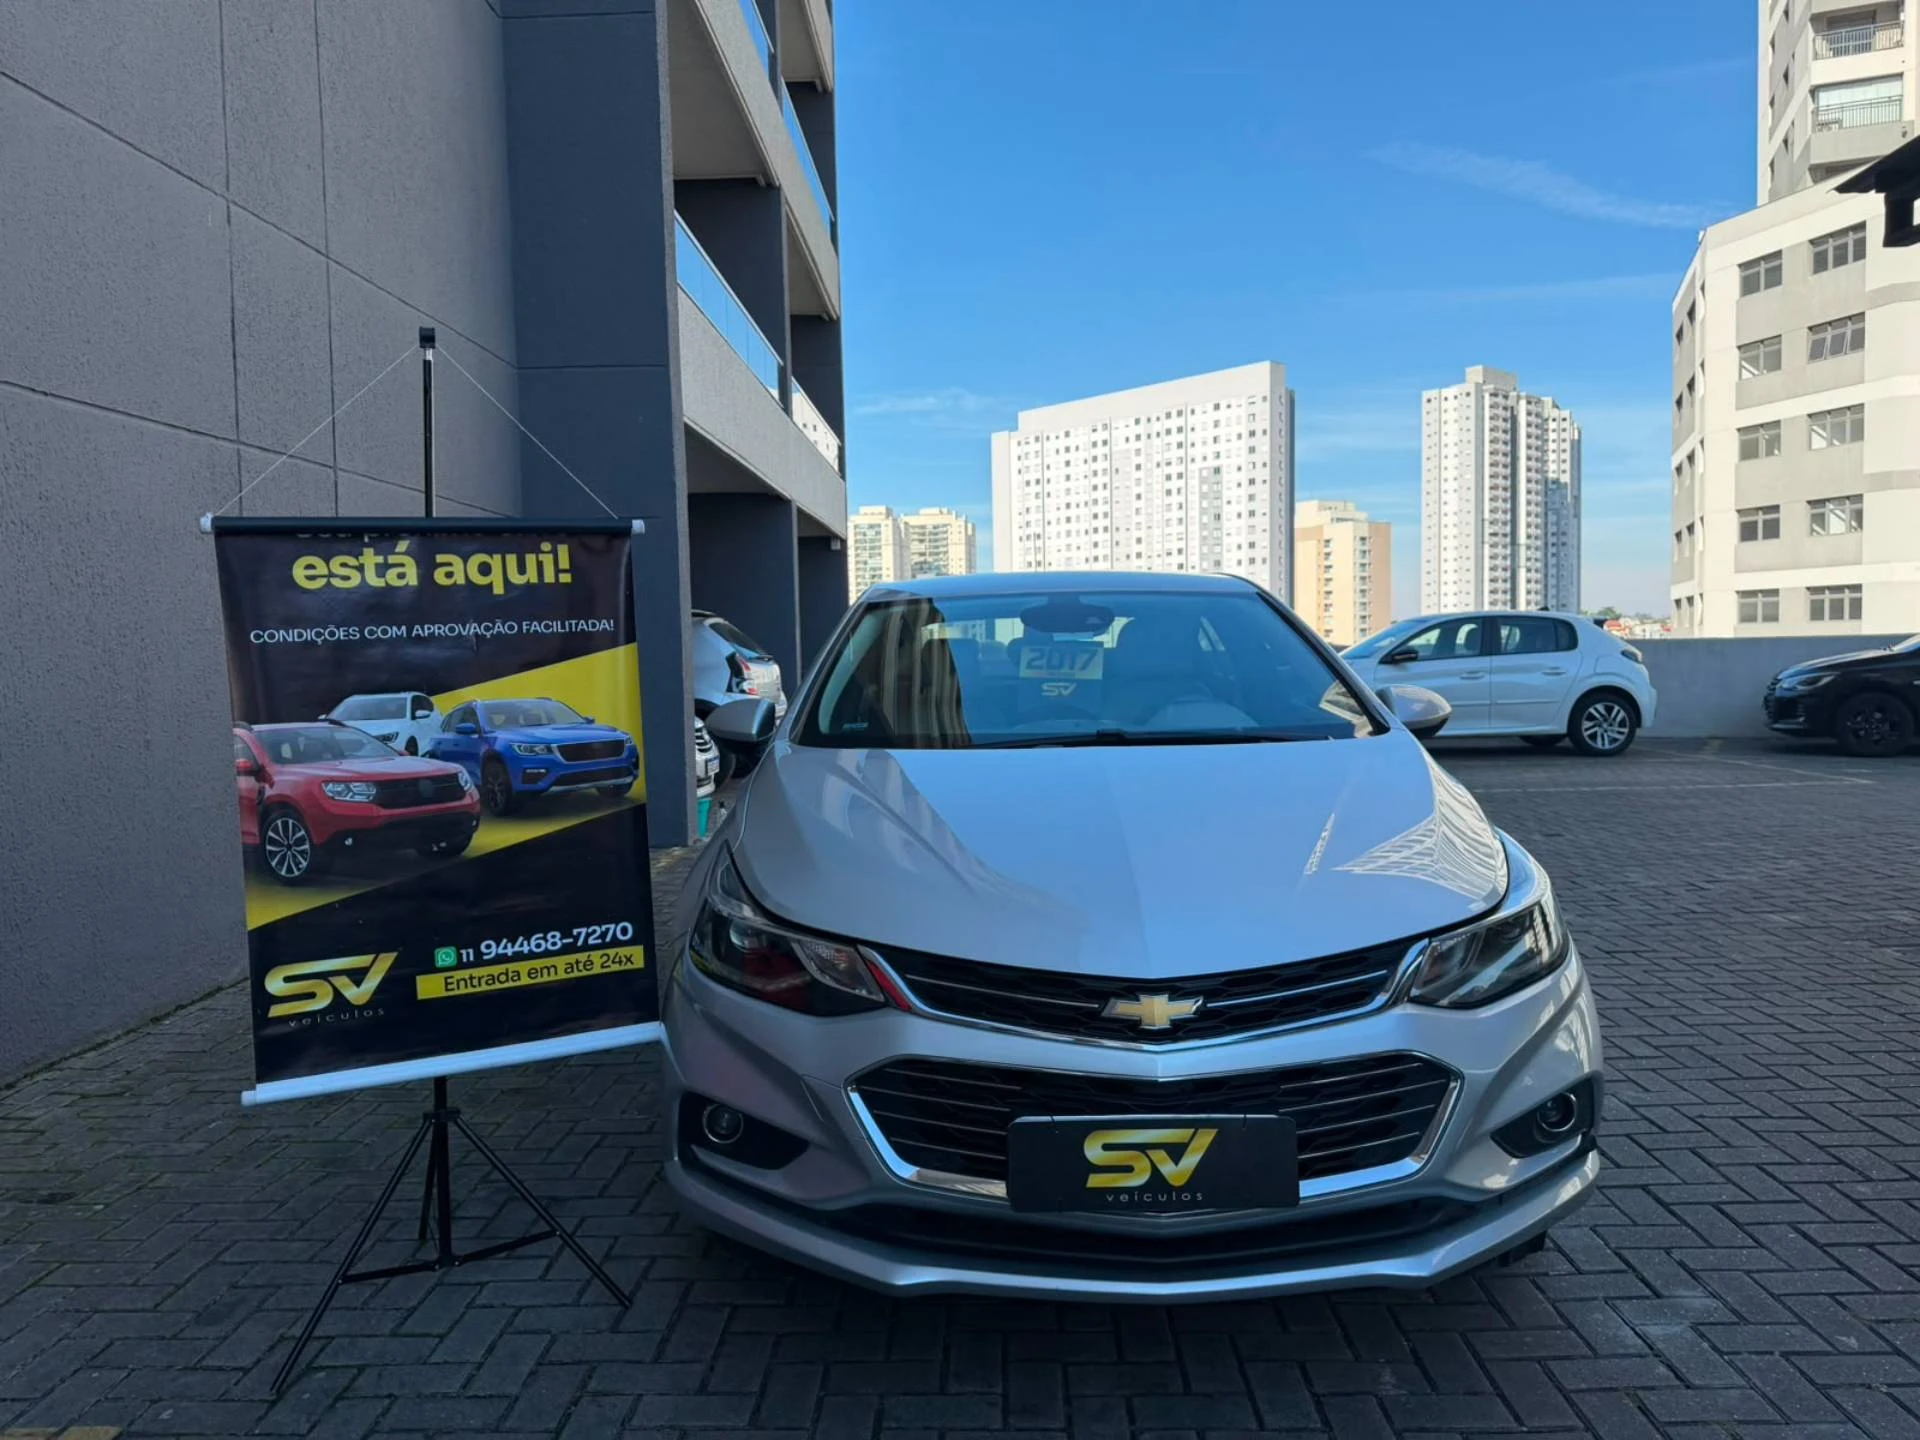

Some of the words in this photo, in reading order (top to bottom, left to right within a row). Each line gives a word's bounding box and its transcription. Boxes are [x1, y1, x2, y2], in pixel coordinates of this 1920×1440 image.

[292, 540, 418, 590] está
[433, 541, 572, 595] aqui!
[250, 624, 360, 645] CONDIÇÕES
[364, 625, 407, 640] COM
[412, 618, 518, 638] APROVAÇÃO
[522, 619, 615, 634] FACILITADA!
[1025, 646, 1098, 671] 2017
[459, 949, 474, 963] 11
[480, 921, 633, 960] 94468-7270
[443, 965, 521, 992] Entrada
[527, 962, 558, 980] em
[563, 954, 594, 975] até
[600, 950, 635, 968] 24x
